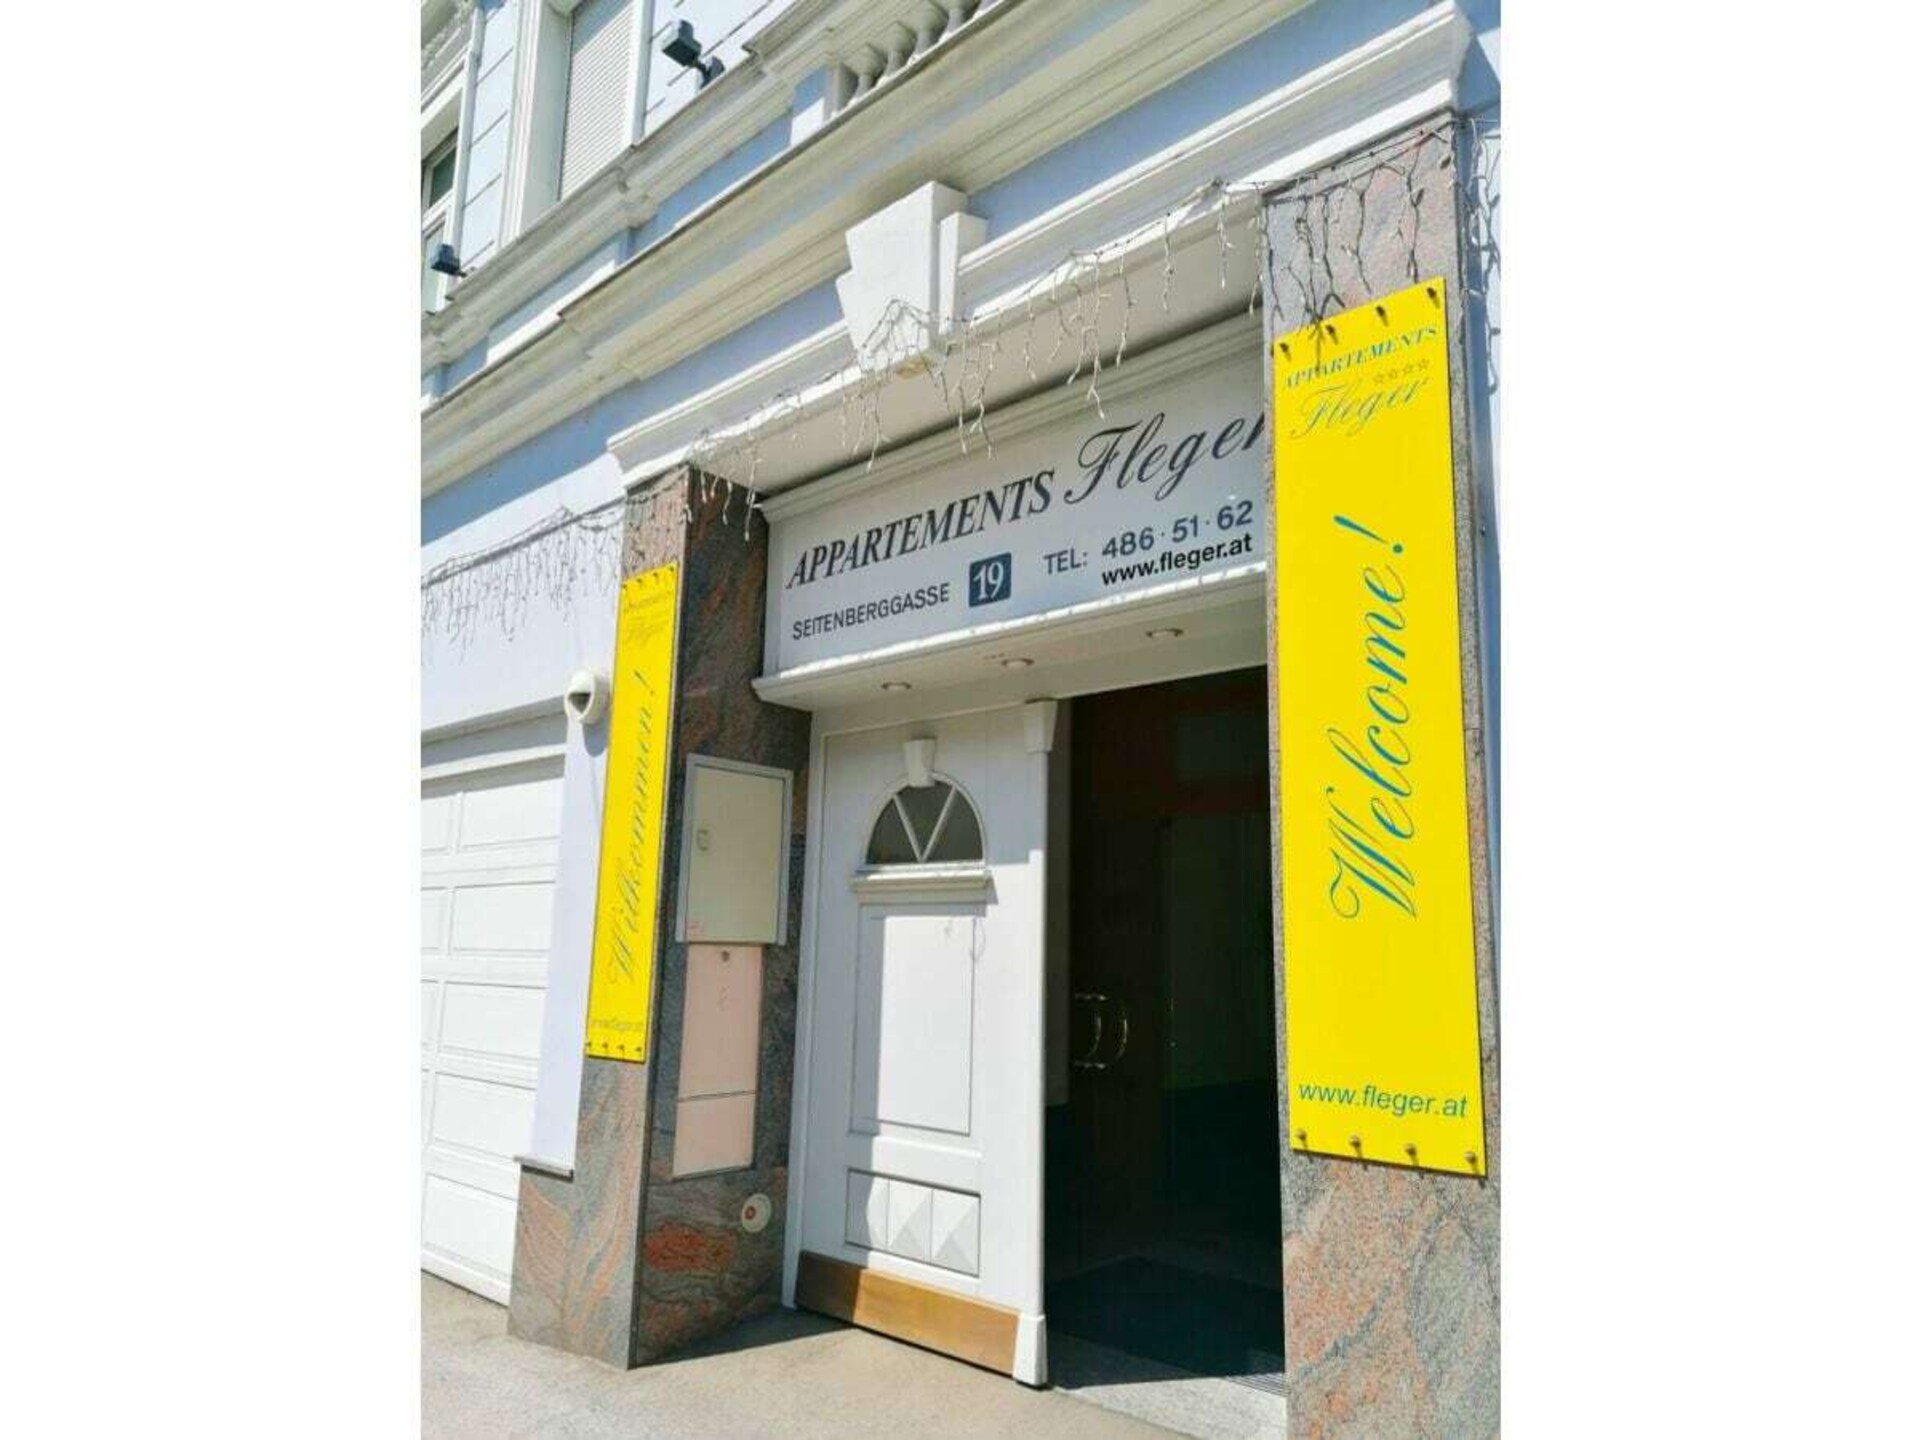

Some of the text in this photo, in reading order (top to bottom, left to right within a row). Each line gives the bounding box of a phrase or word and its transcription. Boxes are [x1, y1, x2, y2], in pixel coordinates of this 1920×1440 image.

[785, 468, 1055, 590] APPARTEMENTS
[1043, 549, 1089, 576] TEL:
[1102, 533, 1253, 586] www.fleger.at
[792, 560, 1005, 641] SEITENBERGGASSE 19
[1326, 514, 1416, 919] Welcome!
[1299, 1082, 1468, 1119] www.fleger.at
